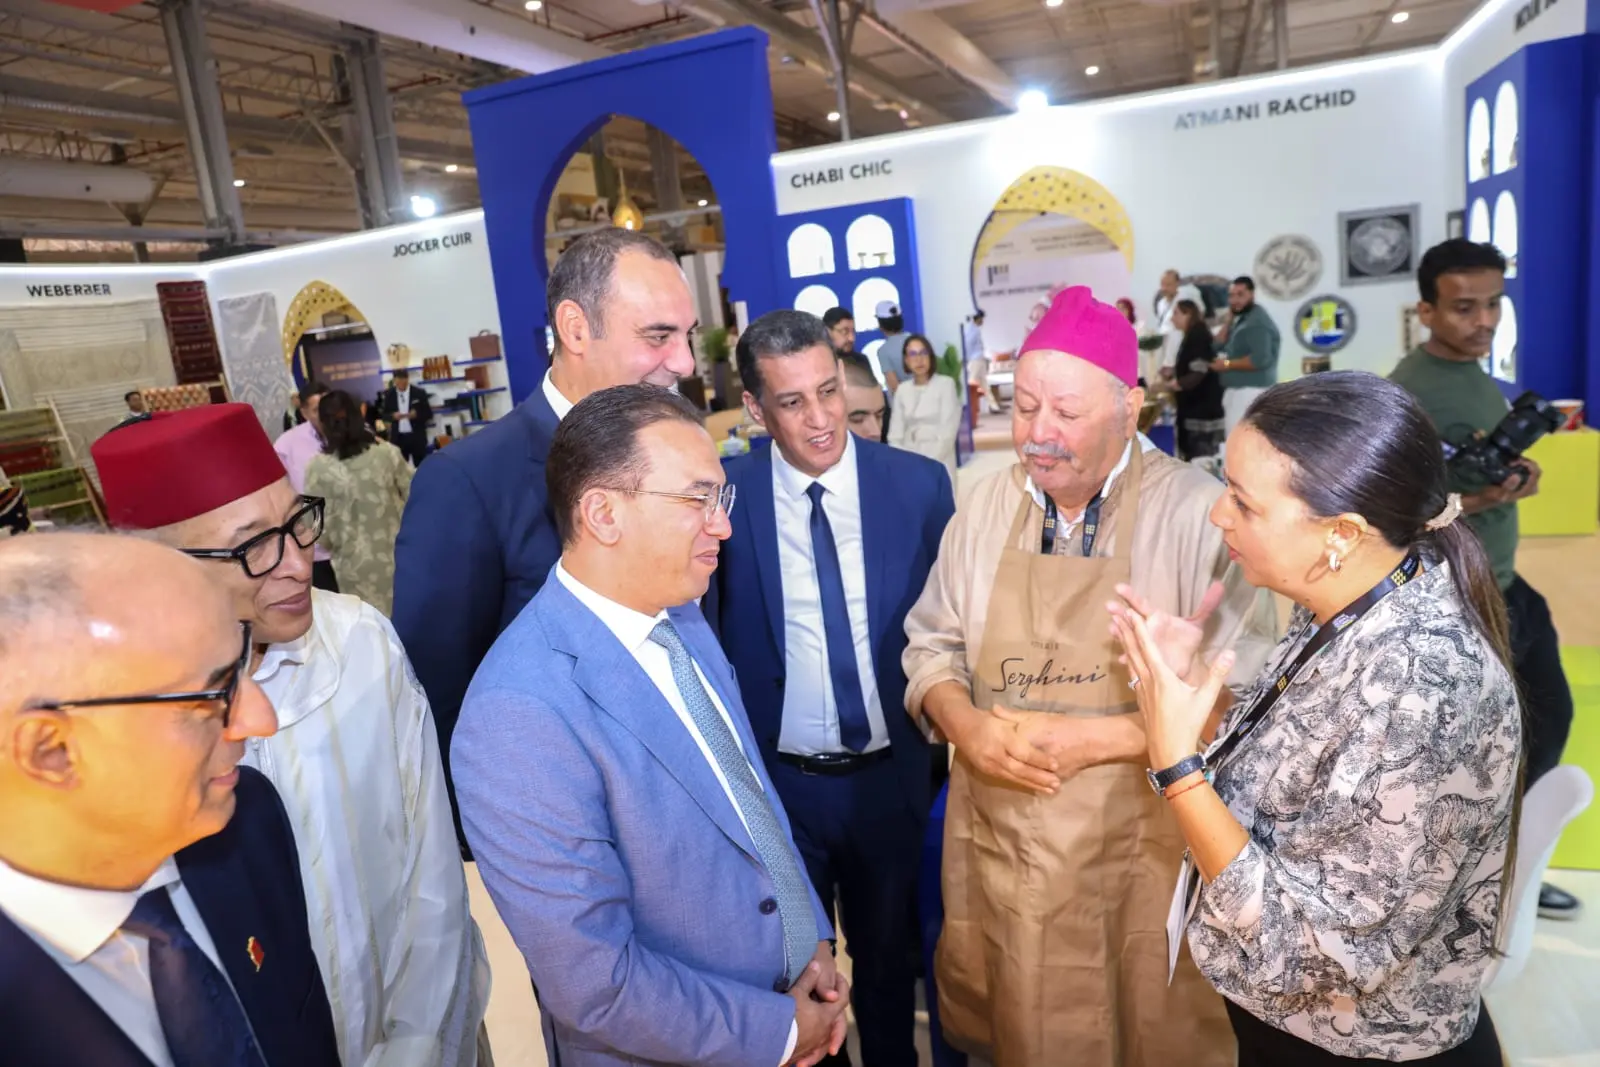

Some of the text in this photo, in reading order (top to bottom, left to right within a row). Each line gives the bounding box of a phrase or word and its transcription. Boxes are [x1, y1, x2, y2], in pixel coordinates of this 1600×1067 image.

[1174, 89, 1356, 132] ATMANI RACHID
[790, 159, 893, 189] CHABI CHIC
[393, 232, 472, 257] JOCKER CUIR
[26, 283, 112, 297] WEBERBER
[991, 657, 1107, 699] Serghini
